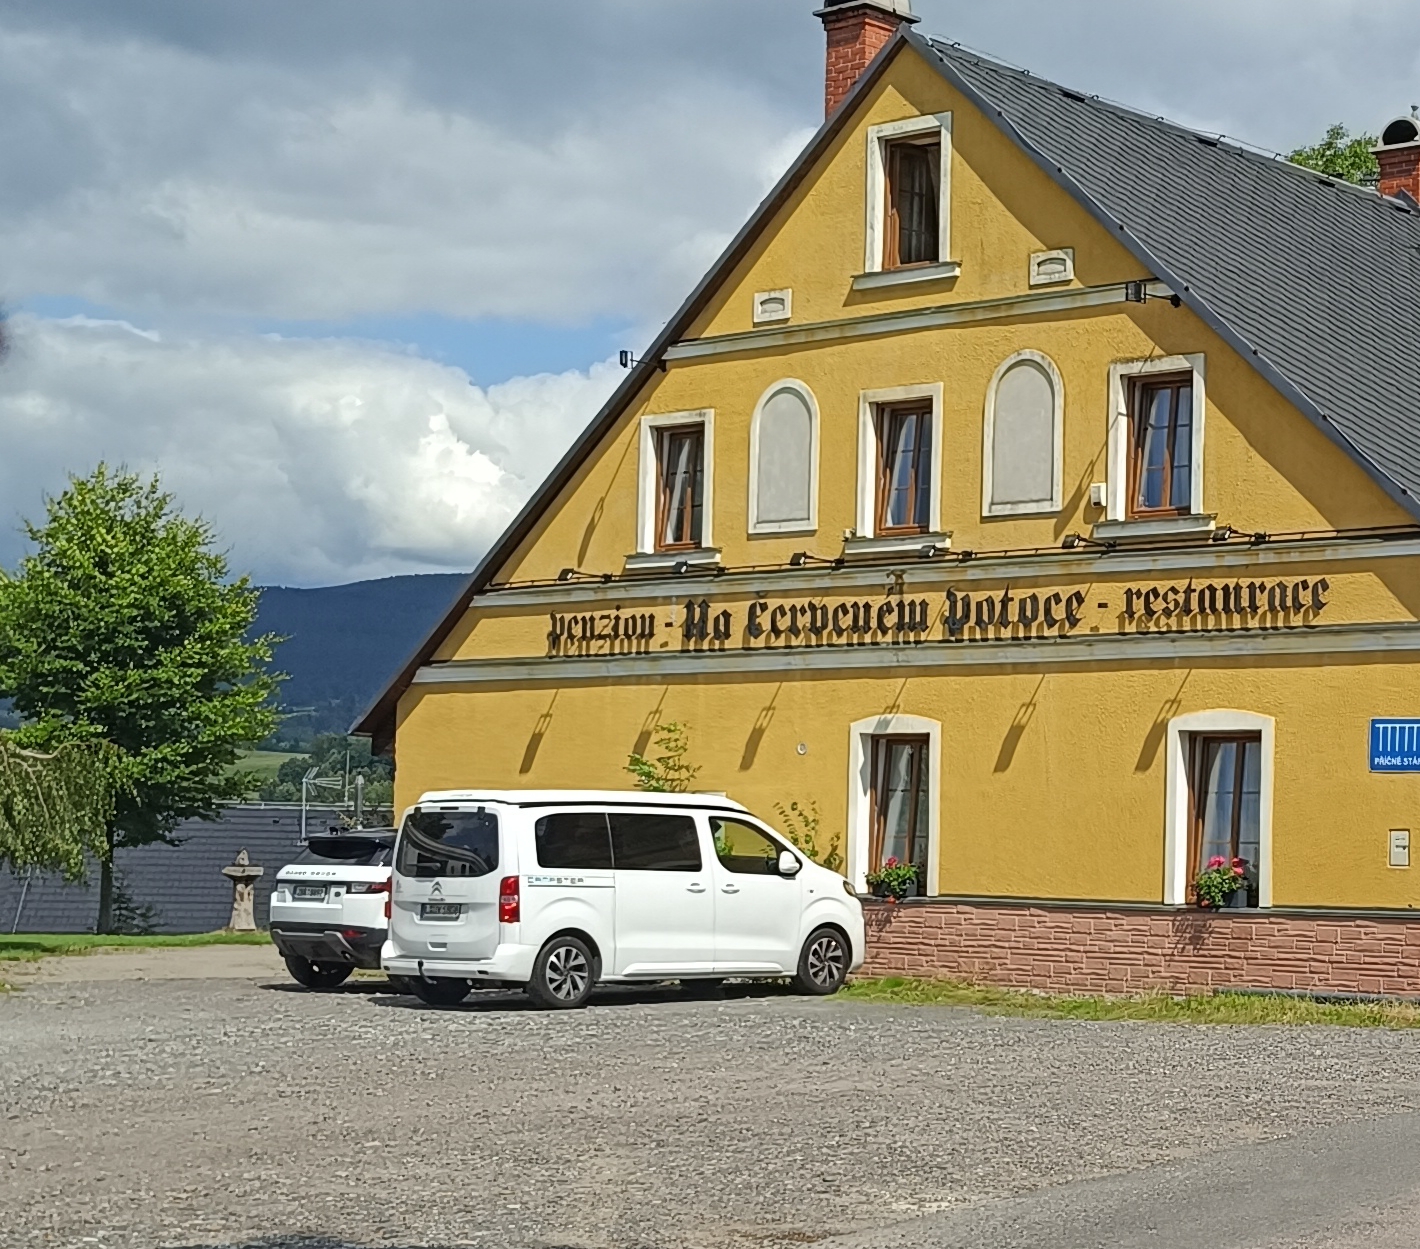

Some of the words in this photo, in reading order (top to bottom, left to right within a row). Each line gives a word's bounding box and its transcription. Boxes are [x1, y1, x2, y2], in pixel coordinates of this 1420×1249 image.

[551, 605, 656, 649] penzion
[683, 599, 733, 643] Na
[1123, 576, 1331, 624] restaurace
